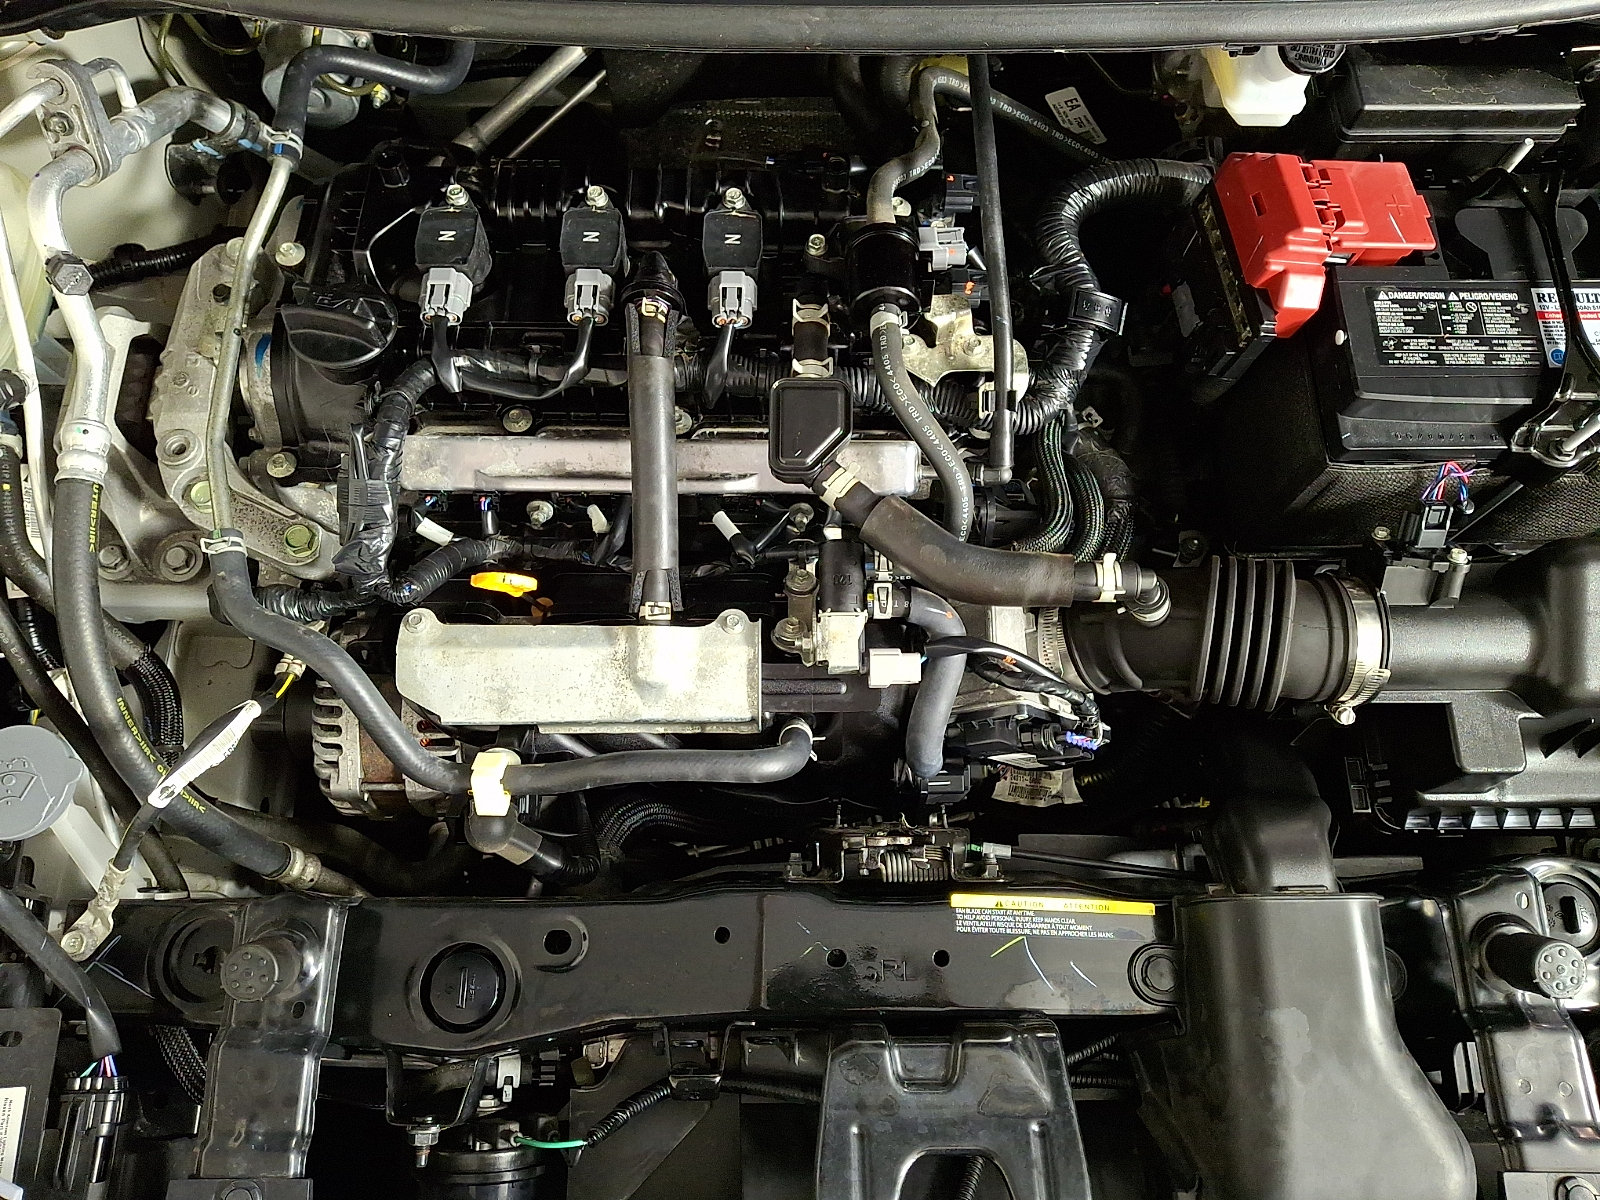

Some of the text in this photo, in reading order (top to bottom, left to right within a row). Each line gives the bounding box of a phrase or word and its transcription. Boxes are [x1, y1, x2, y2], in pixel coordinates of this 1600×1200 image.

[1388, 291, 1445, 300] DANGER/POISON
[1005, 900, 1044, 908] CAUTION
[1063, 902, 1110, 911] ATTENTION
